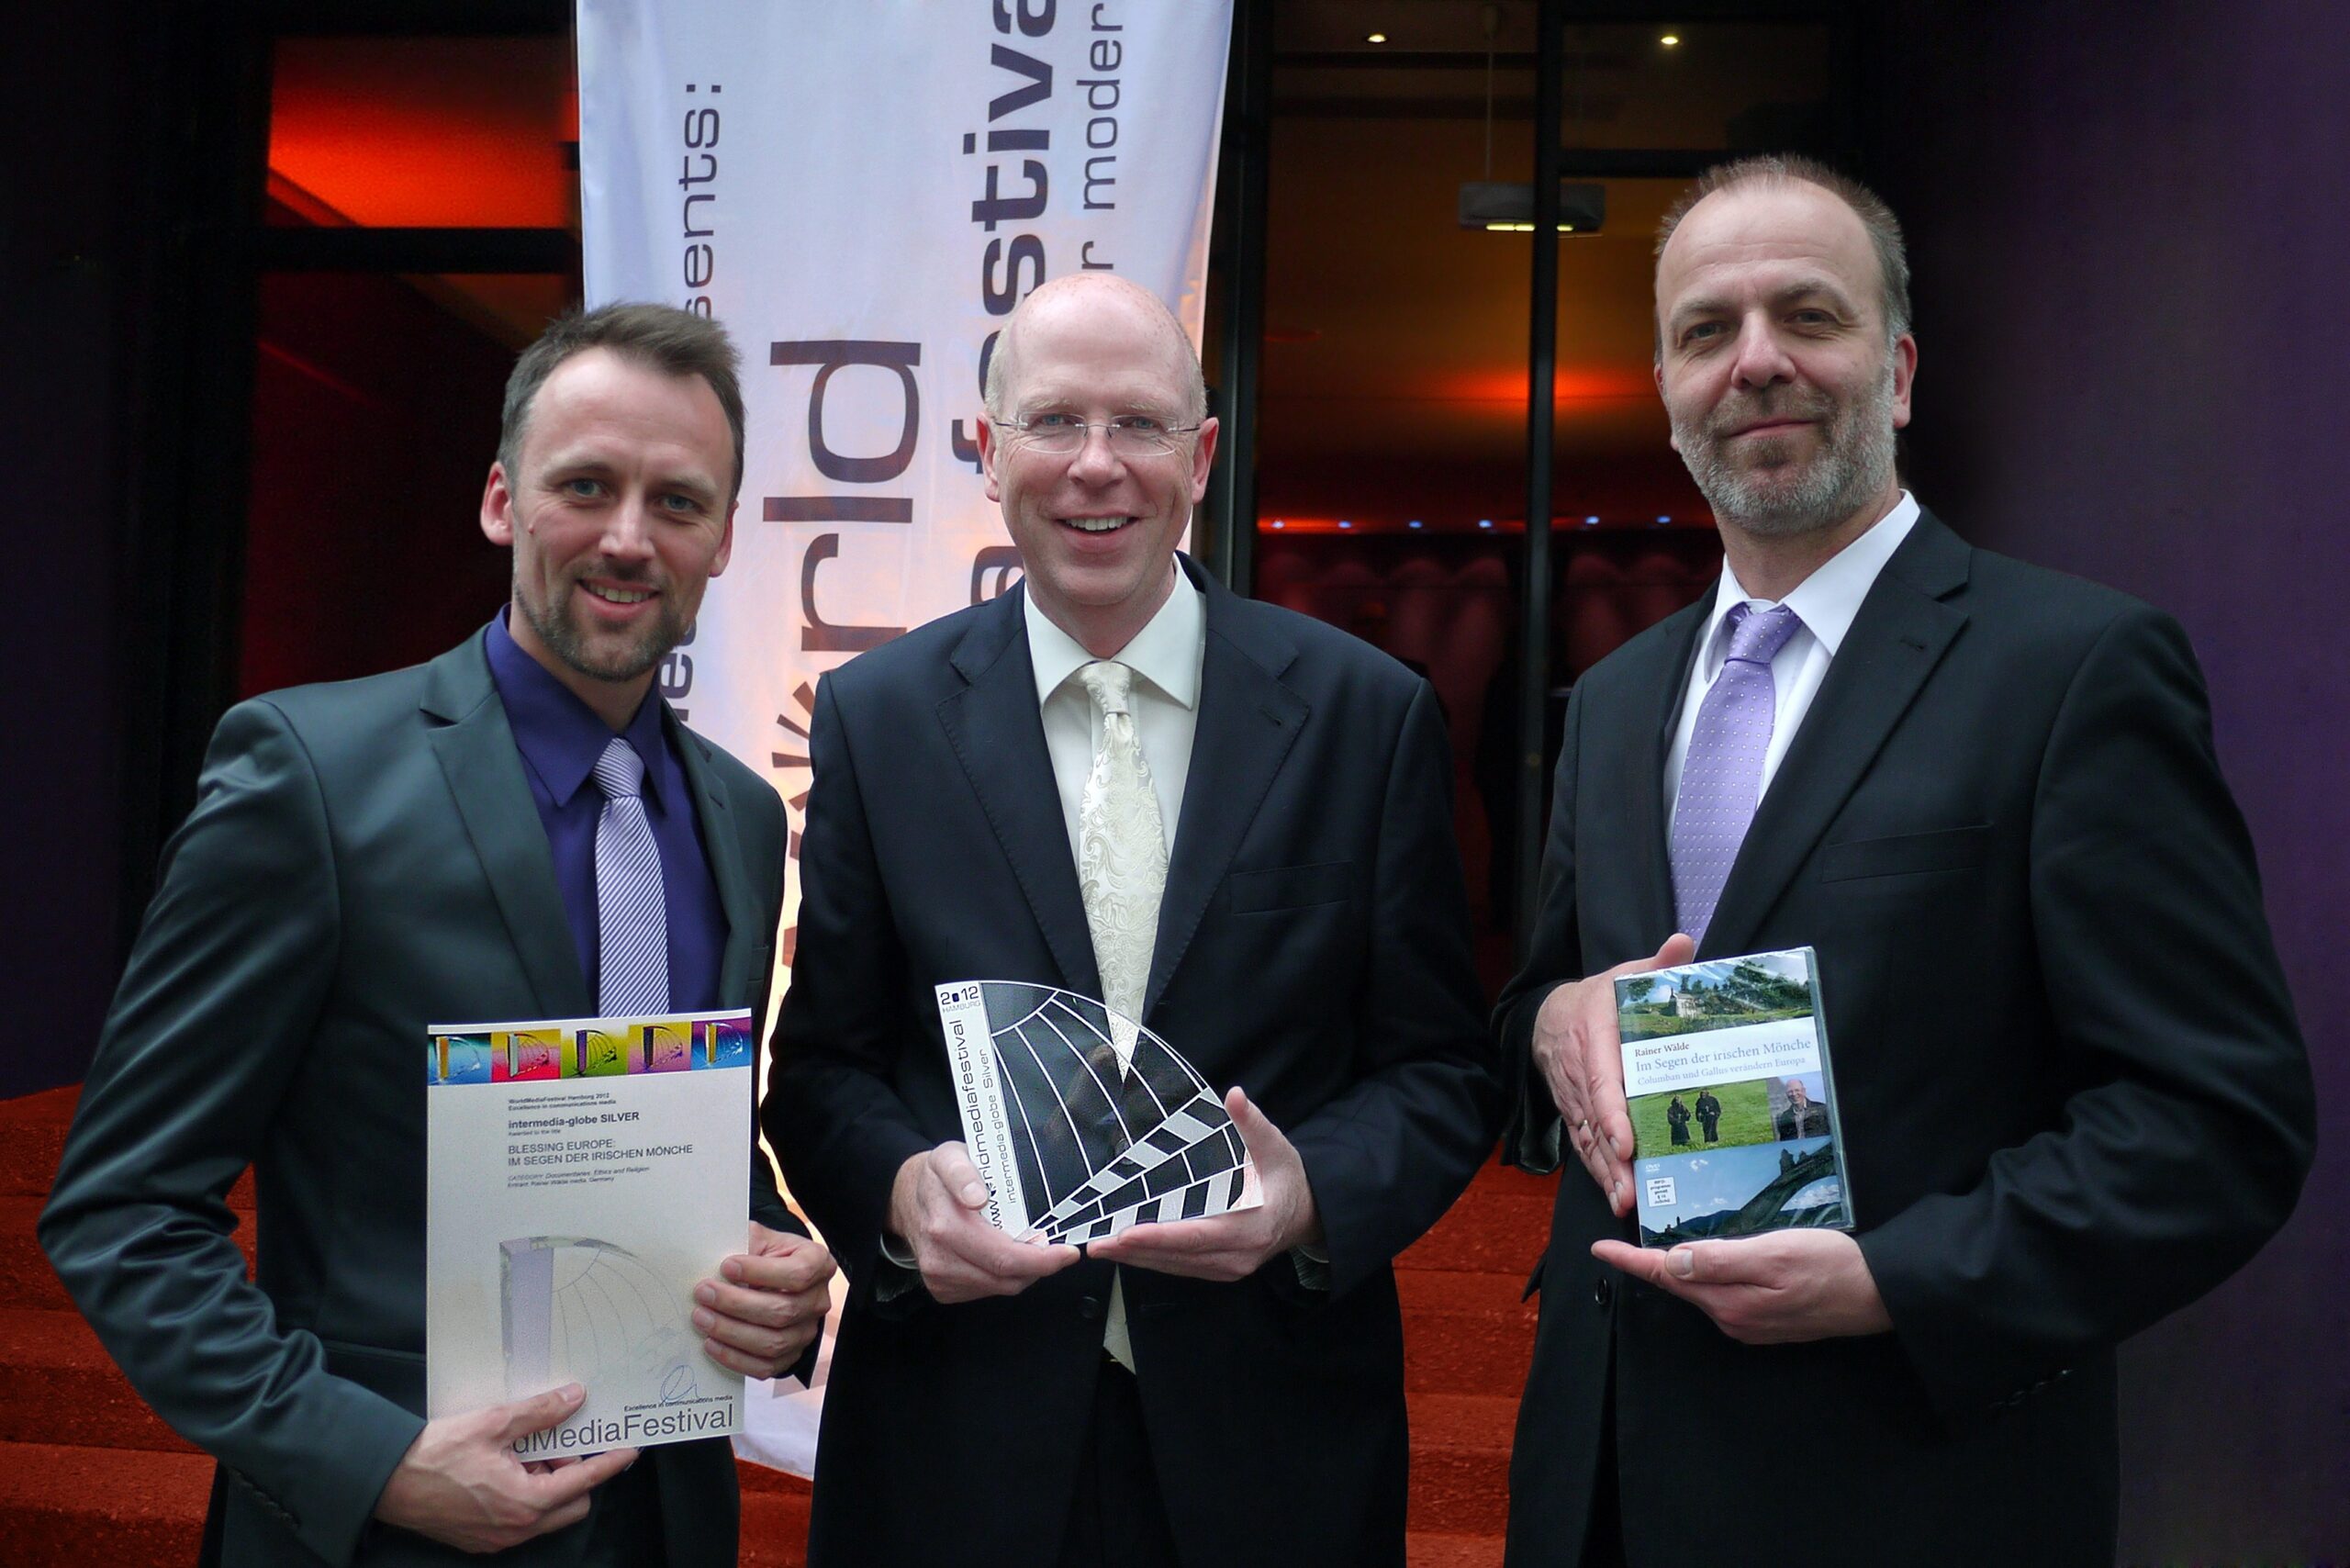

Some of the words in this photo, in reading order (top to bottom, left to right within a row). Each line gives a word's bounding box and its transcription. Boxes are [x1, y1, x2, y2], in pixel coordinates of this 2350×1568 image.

[1634, 1047, 1662, 1058] Rainer
[1663, 1042, 1690, 1053] Wälde
[1636, 1061, 1651, 1072] Im
[1654, 1056, 1688, 1070] Segen
[1691, 1052, 1710, 1063] der
[1713, 1046, 1760, 1061] irischen
[1763, 1038, 1812, 1055] Mönche
[979, 1048, 994, 1090] Silver
[1637, 1073, 1681, 1086] Columban
[1683, 1070, 1700, 1079] und
[1701, 1066, 1729, 1078] Gallus
[1774, 1057, 1806, 1070] Europa
[508, 1114, 598, 1129] intermedia-globe
[600, 1111, 640, 1124] SILVER
[508, 1141, 565, 1155] BLESSING
[566, 1138, 616, 1151] EUROPE:
[508, 1157, 520, 1167] IM
[523, 1154, 563, 1166] SEGEN
[565, 1152, 588, 1163] DER
[591, 1148, 643, 1161] IRISCHEN
[714, 1394, 733, 1402] media
